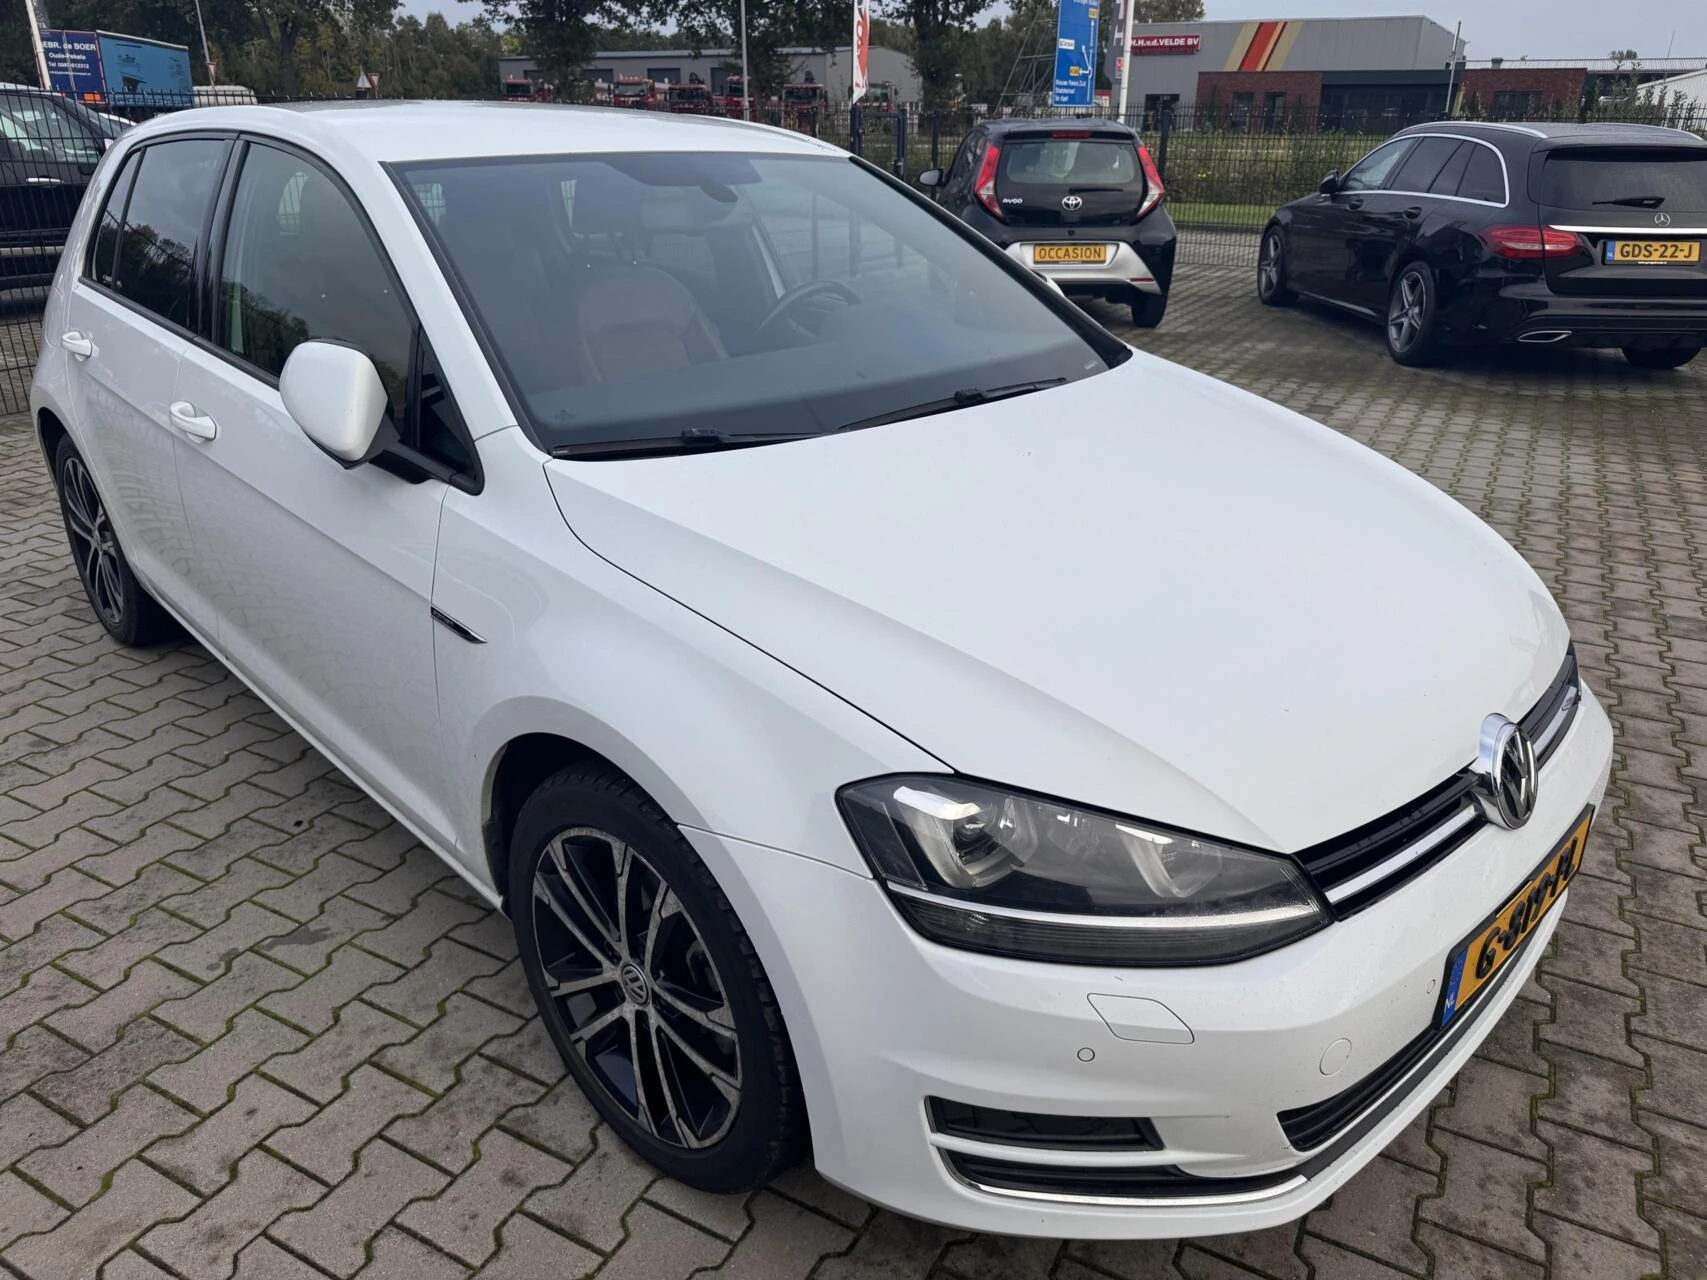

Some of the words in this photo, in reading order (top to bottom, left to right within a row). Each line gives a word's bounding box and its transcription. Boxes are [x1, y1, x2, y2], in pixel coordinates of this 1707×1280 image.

[73, 43, 96, 51] BOER
[1038, 247, 1102, 260] OCCASION
[1620, 243, 1693, 259] GDS-22-J
